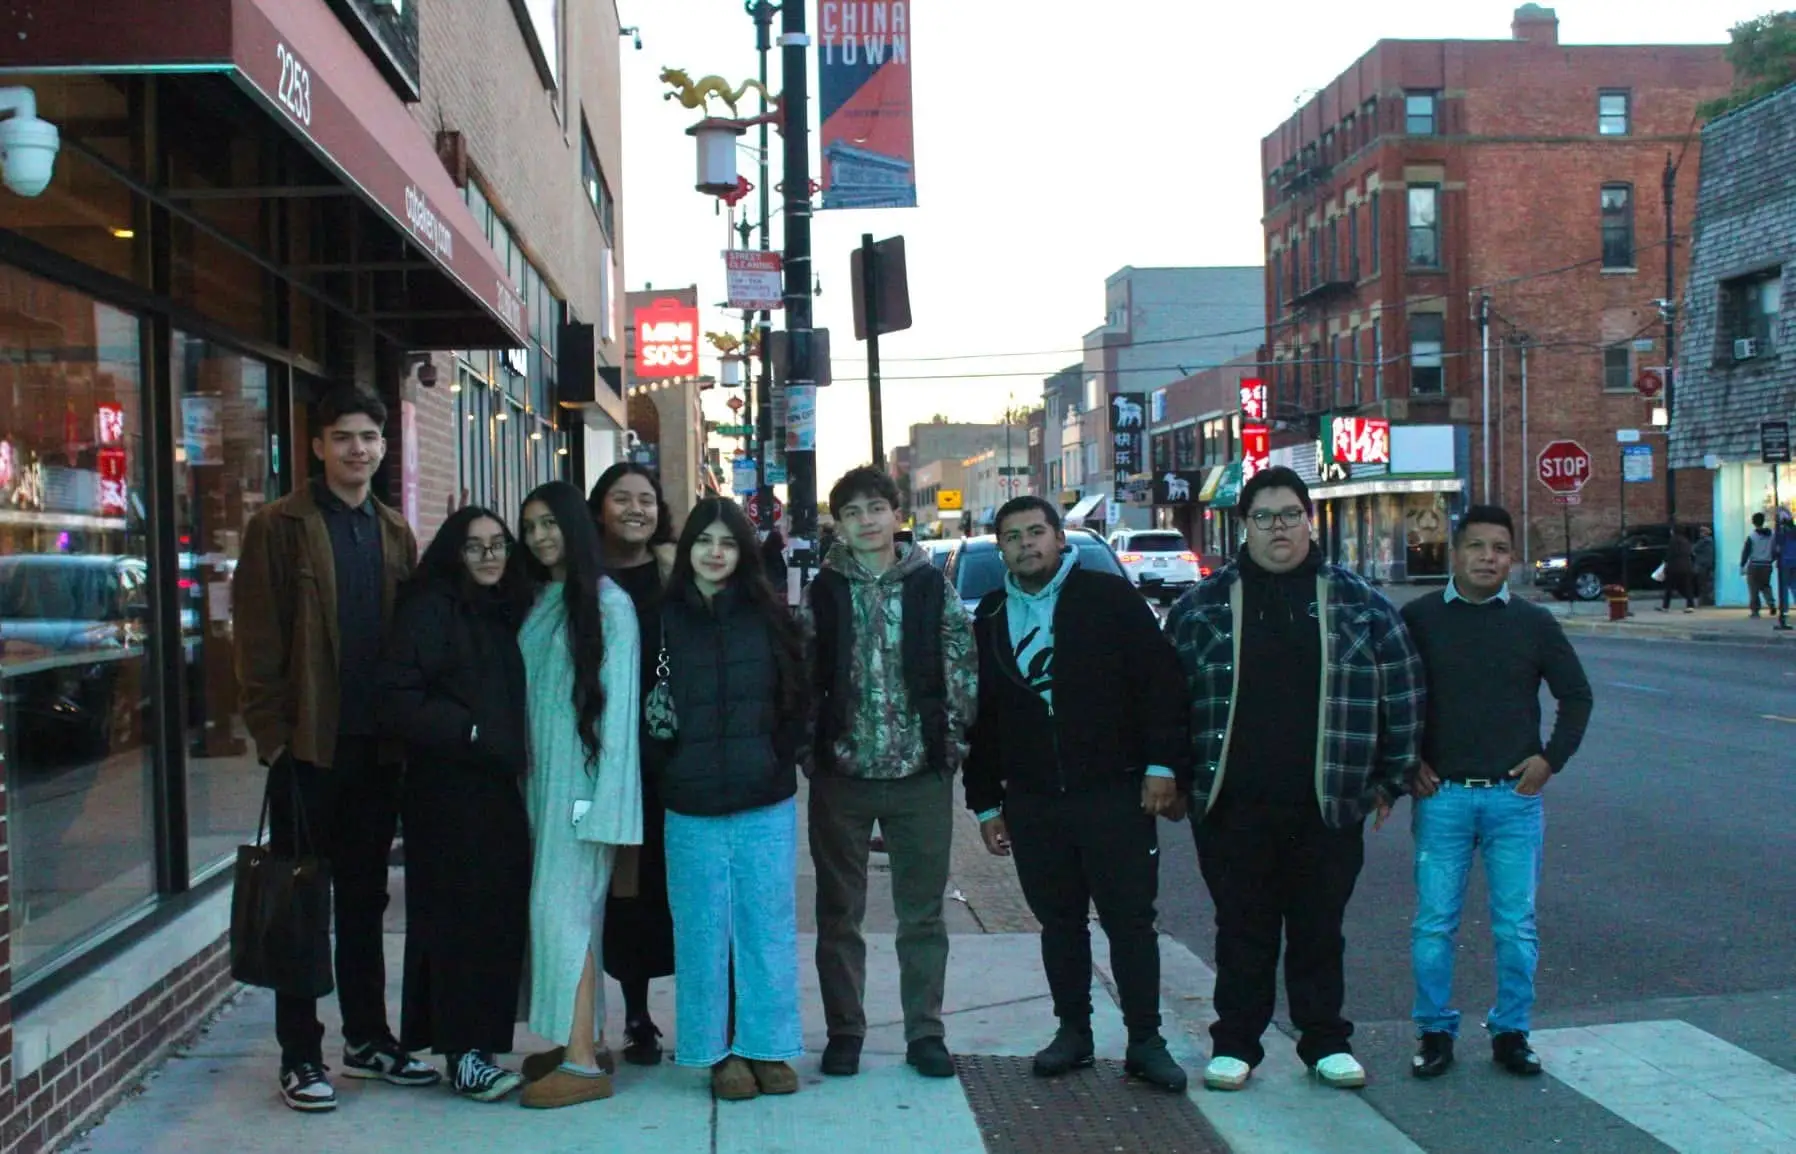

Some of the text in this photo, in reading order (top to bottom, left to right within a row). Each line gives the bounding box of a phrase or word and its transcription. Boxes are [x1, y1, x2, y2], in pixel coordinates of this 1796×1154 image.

[823, 2, 906, 33] CHINA
[823, 34, 907, 65] TOWN
[277, 43, 310, 126] 2253
[642, 321, 692, 342] MINI
[1541, 456, 1586, 477] STOP
